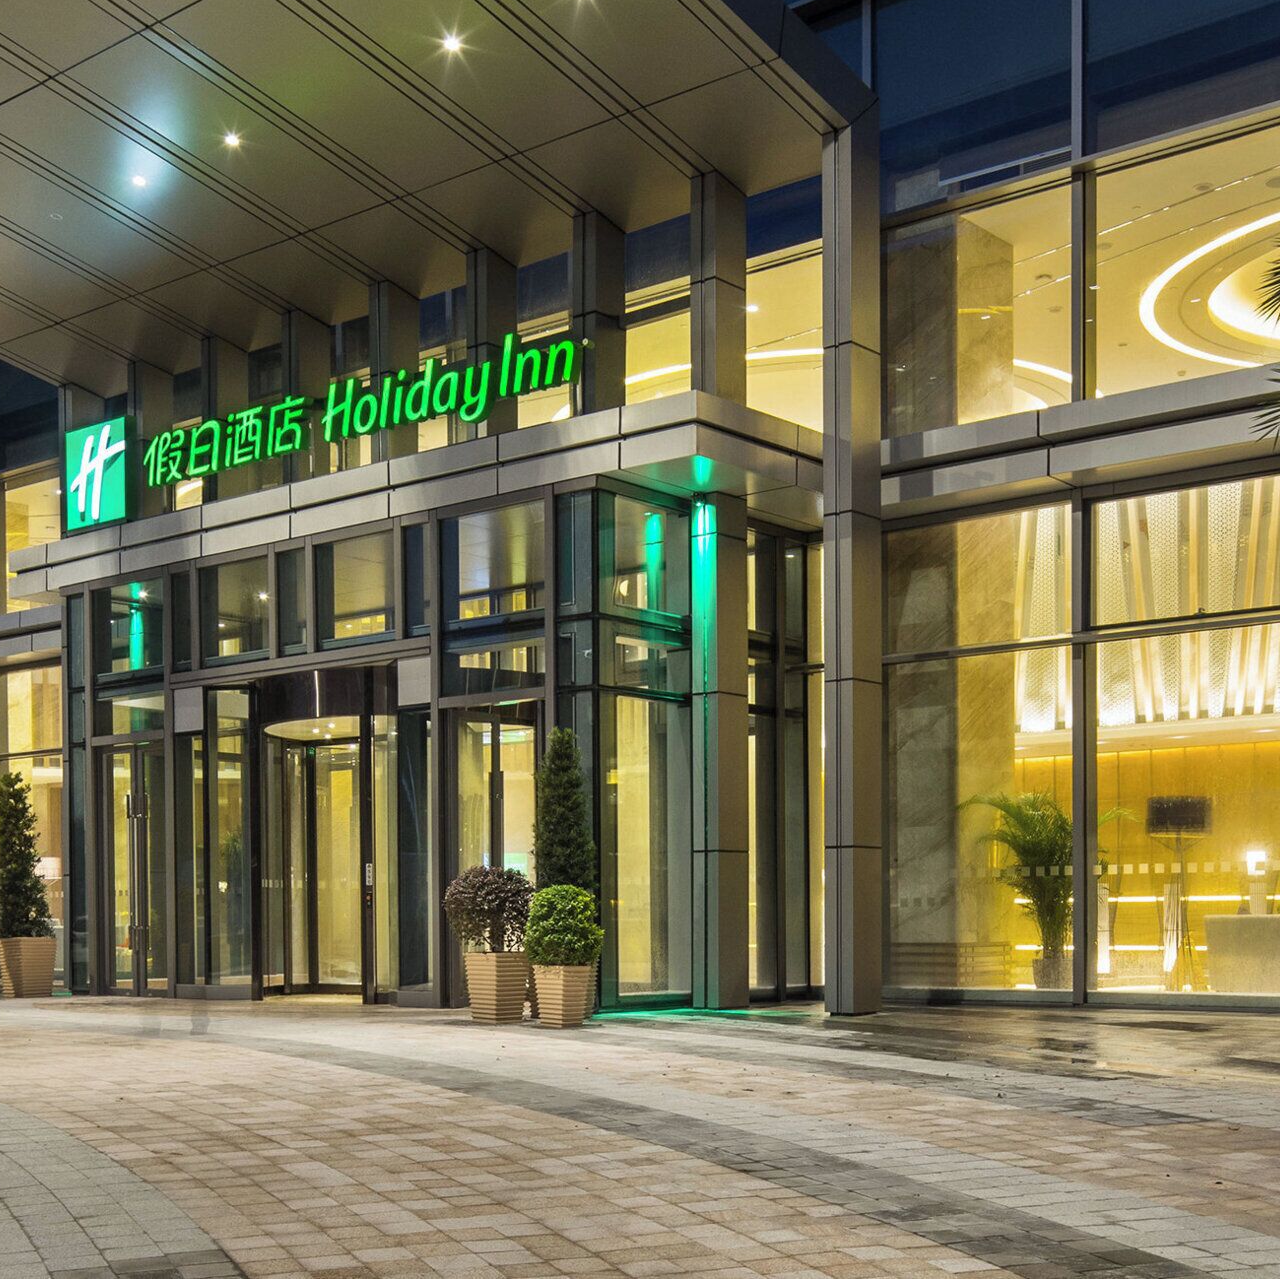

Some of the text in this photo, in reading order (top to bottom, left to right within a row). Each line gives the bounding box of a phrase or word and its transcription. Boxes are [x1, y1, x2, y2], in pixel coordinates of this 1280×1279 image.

[321, 333, 575, 442] Holiday Inn
[142, 394, 307, 487] 假日酒店
